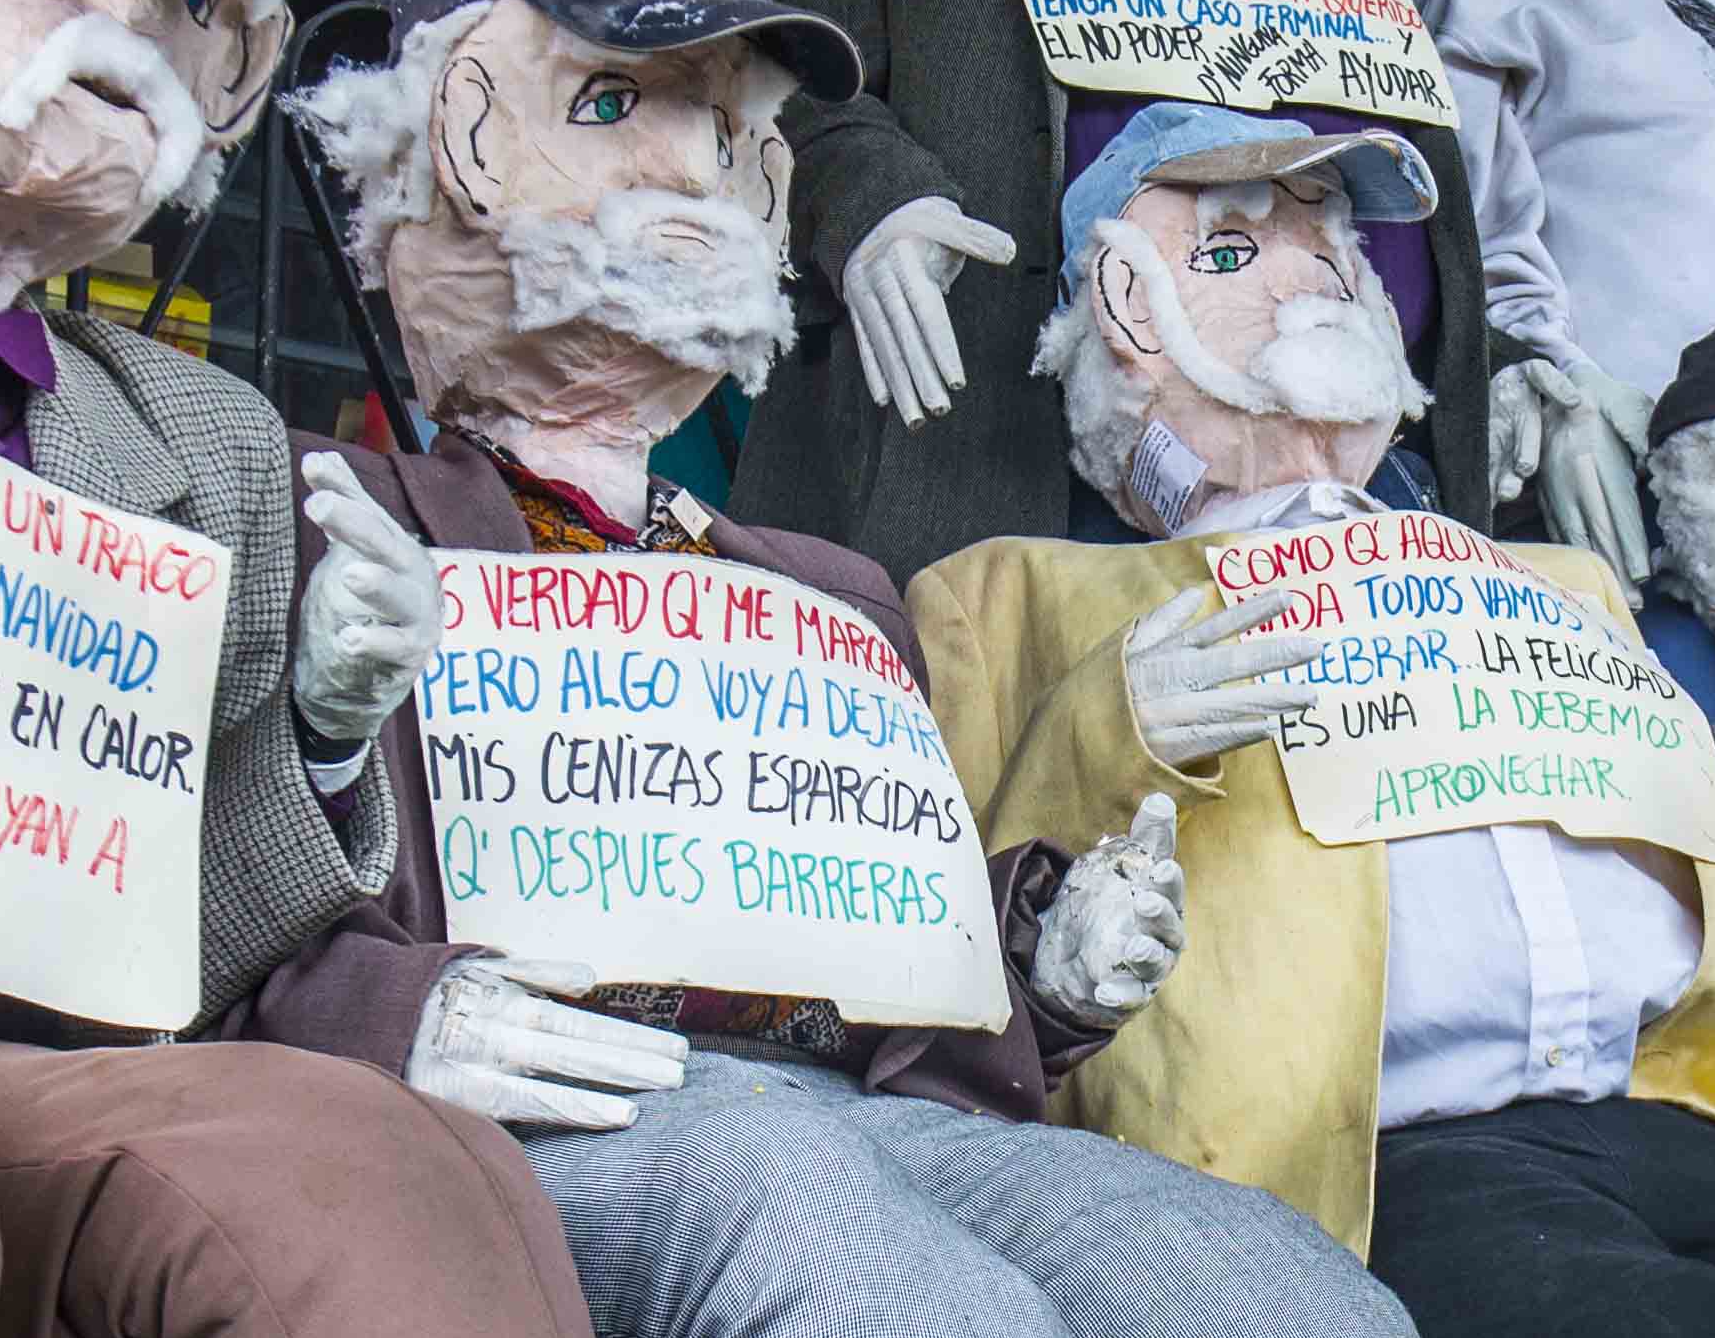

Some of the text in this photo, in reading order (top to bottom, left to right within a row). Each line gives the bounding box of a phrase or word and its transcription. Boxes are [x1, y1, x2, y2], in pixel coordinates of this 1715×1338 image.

[1037, 21, 1081, 62] EL
[1083, 22, 1122, 63] NO
[1127, 22, 1212, 64] PODER
[1257, 38, 1328, 102] FORMA
[1397, 26, 1414, 56] Y
[4, 480, 62, 556] UN
[75, 507, 217, 601] TRAGO
[1218, 528, 1335, 592] COMO
[478, 563, 650, 636] VERDAD
[662, 568, 712, 644] Q'
[723, 581, 775, 642] ME
[1354, 573, 1464, 620] TODOS
[1469, 574, 1584, 632] VAMOS
[1475, 627, 1521, 675] LA
[10, 683, 66, 754] EN
[420, 646, 541, 722] PERO
[561, 646, 682, 715] ALGO
[700, 657, 775, 738] VOY
[777, 666, 810, 730] A
[1278, 681, 1684, 753] ES UNA LA DEBEMOS
[1374, 753, 1629, 824] APROVECHAR
[88, 815, 130, 896] A
[443, 814, 491, 902] Q'
[510, 824, 706, 912] DESPUES
